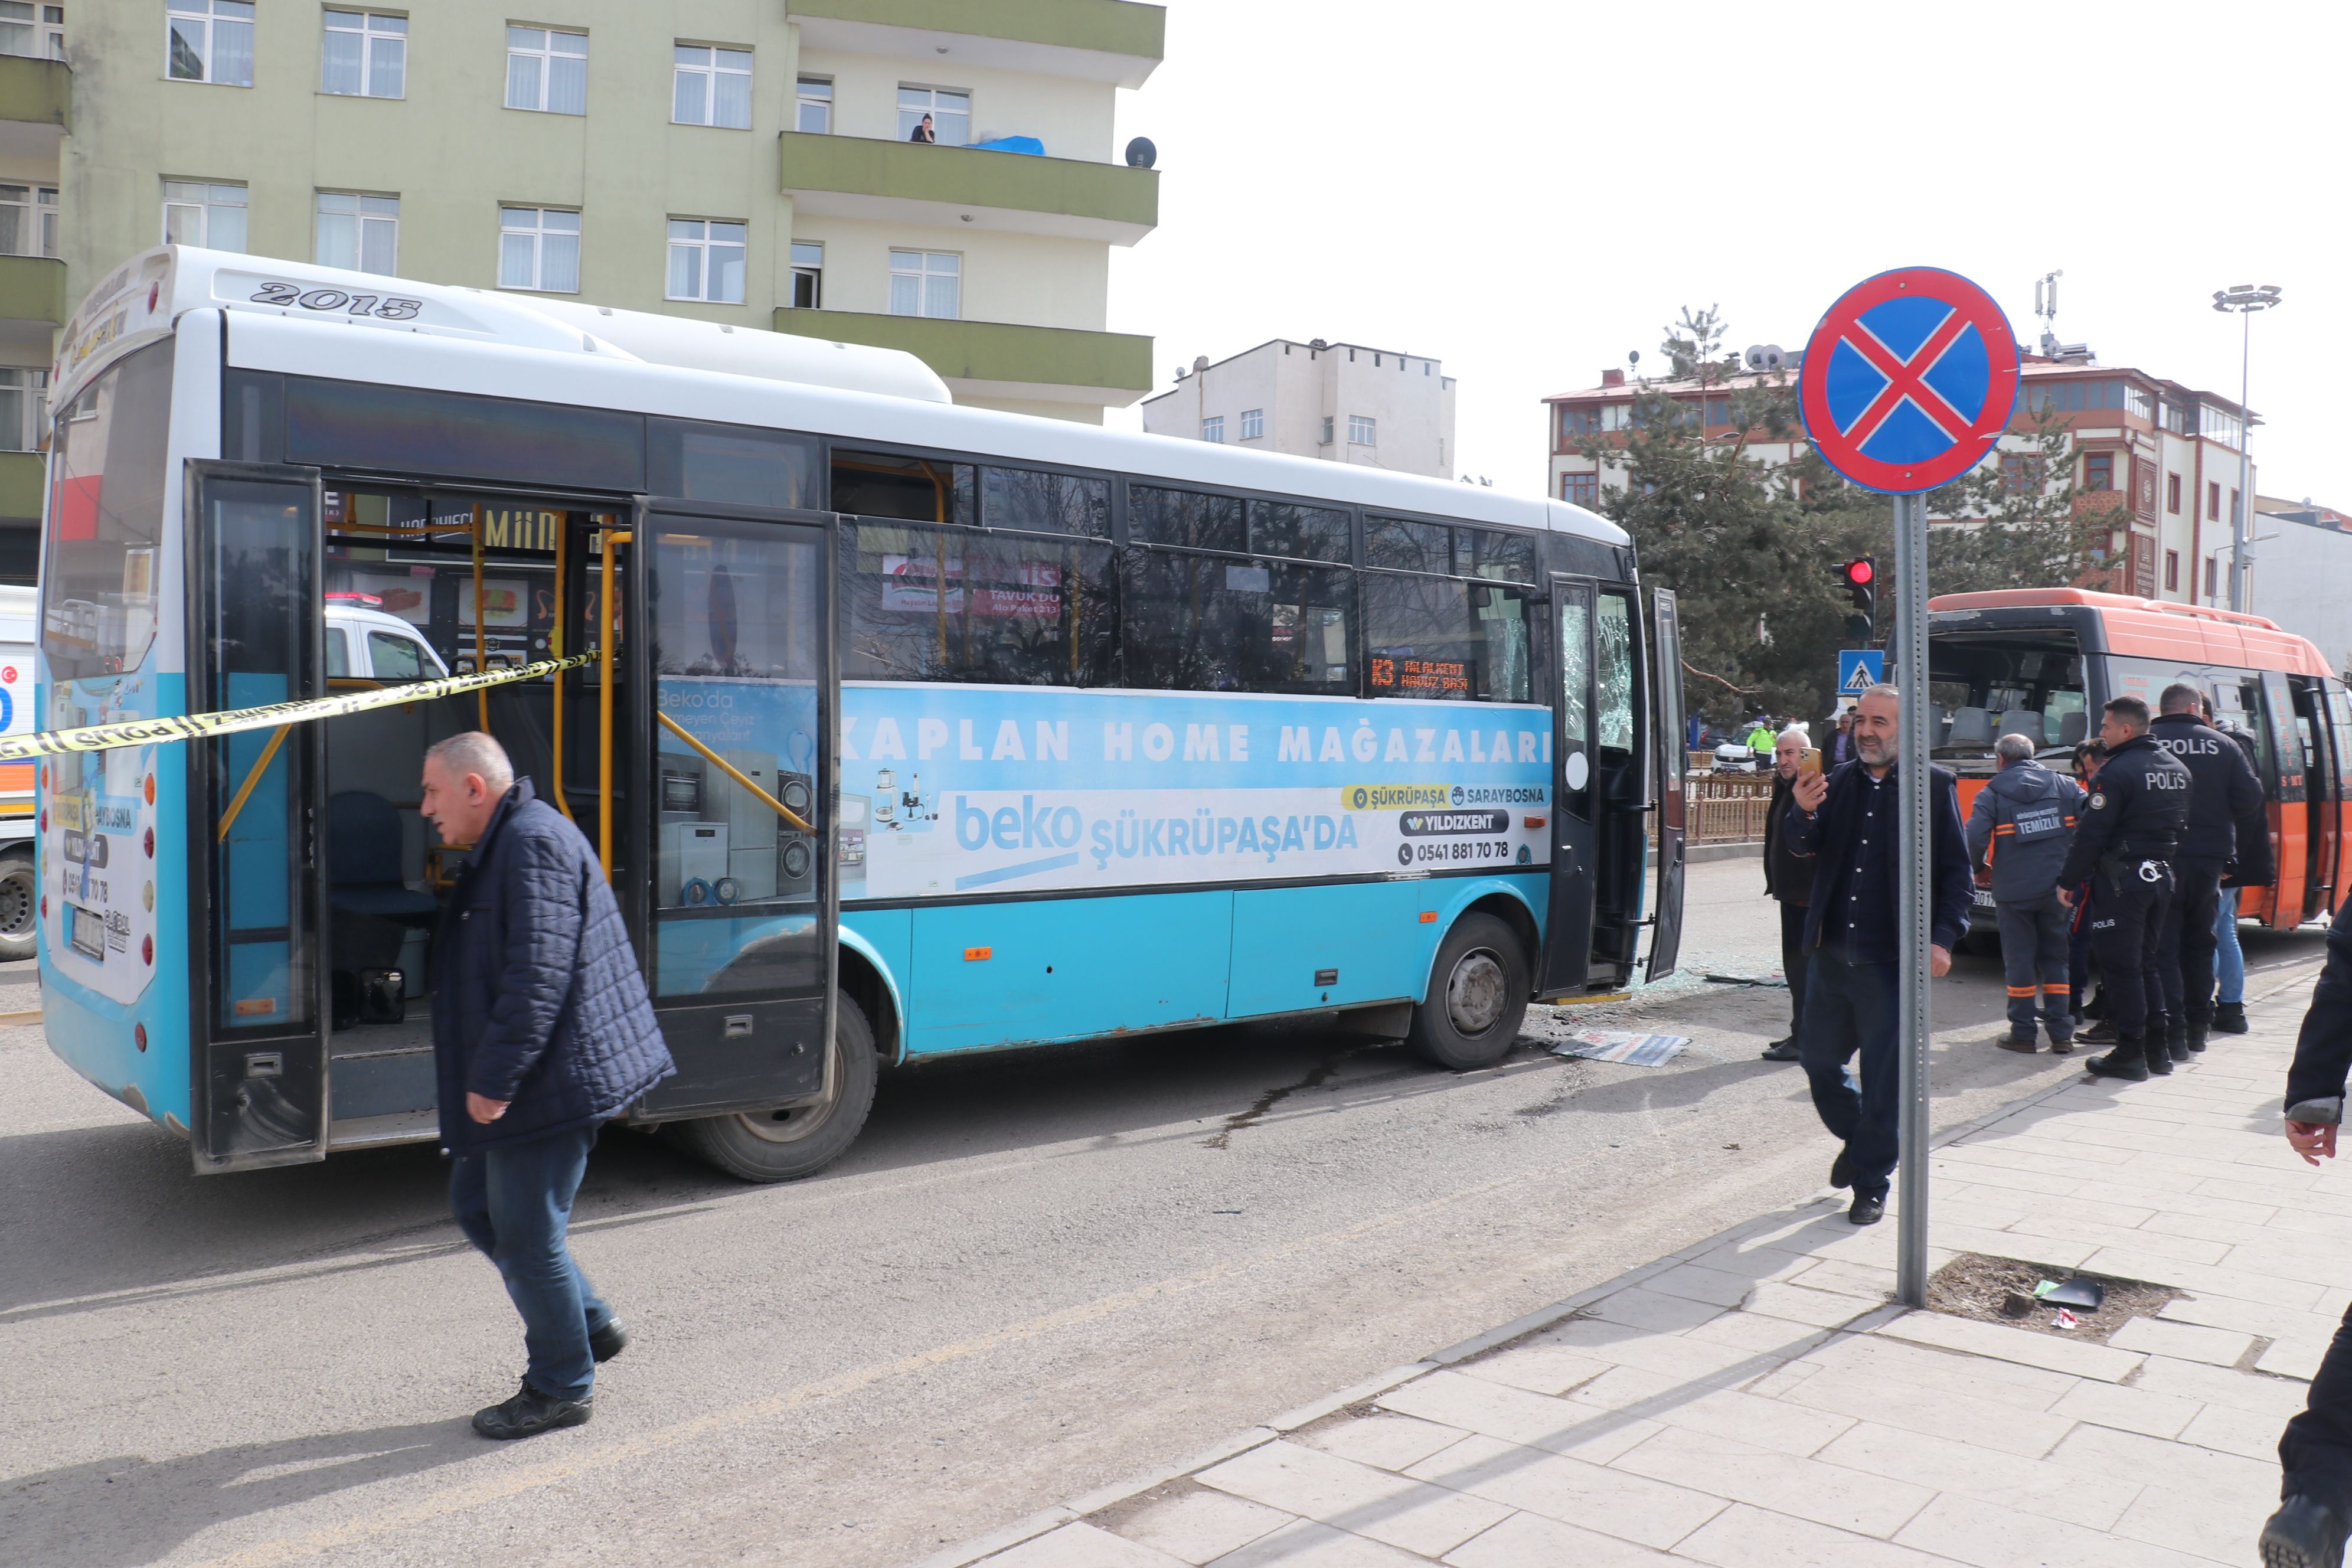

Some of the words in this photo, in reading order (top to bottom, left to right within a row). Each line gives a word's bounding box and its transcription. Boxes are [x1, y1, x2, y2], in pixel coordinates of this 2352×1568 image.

[250, 282, 422, 320] 2015
[989, 590, 1036, 602] TAVUK
[1371, 658, 1394, 685] K3
[1103, 721, 1249, 762] HOME
[1278, 717, 1551, 763] MAĞAZALARI
[1371, 786, 1446, 809] ŞÜKRÜPAŞA
[1466, 787, 1544, 804] SARAYBOSNA
[955, 794, 1083, 851] beko
[1090, 808, 1358, 871] ŞÜKRÜPAŞA'DA
[1425, 814, 1494, 831] YILDIZKENT
[2018, 814, 2062, 835] TEMİZLİK
[1417, 844, 1448, 861] 0541
[1452, 843, 1473, 860] 881
[1476, 842, 1491, 858] 70
[1494, 841, 1508, 857] 78
